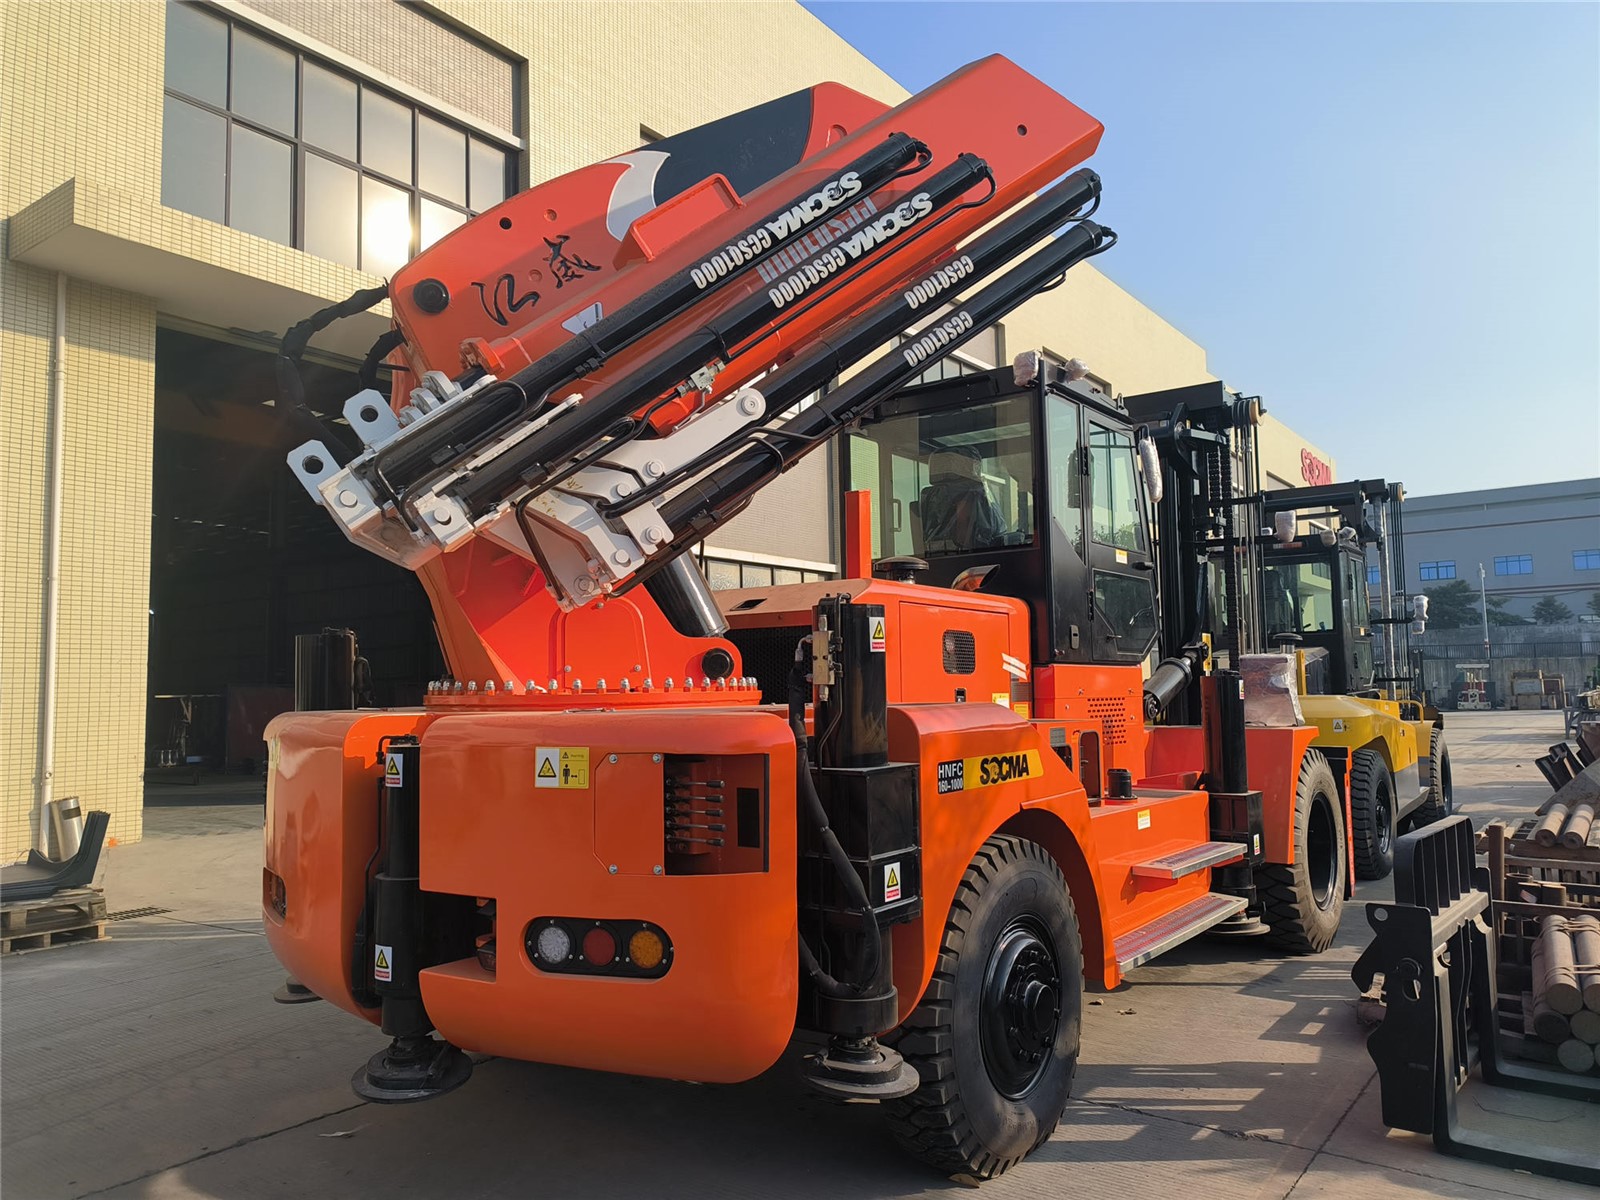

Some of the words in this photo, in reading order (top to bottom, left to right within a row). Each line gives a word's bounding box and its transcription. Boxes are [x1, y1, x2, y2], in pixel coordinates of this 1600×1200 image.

[765, 171, 862, 240] SOCMA
[839, 192, 933, 259] SOCMA
[691, 229, 773, 289] CCSQ1000
[769, 247, 846, 308] CCSQ1000
[904, 255, 974, 309] CCSQ1000
[903, 310, 974, 367] CCSQ1000
[938, 762, 963, 779] HNFC
[980, 754, 1029, 785] SOCMA
